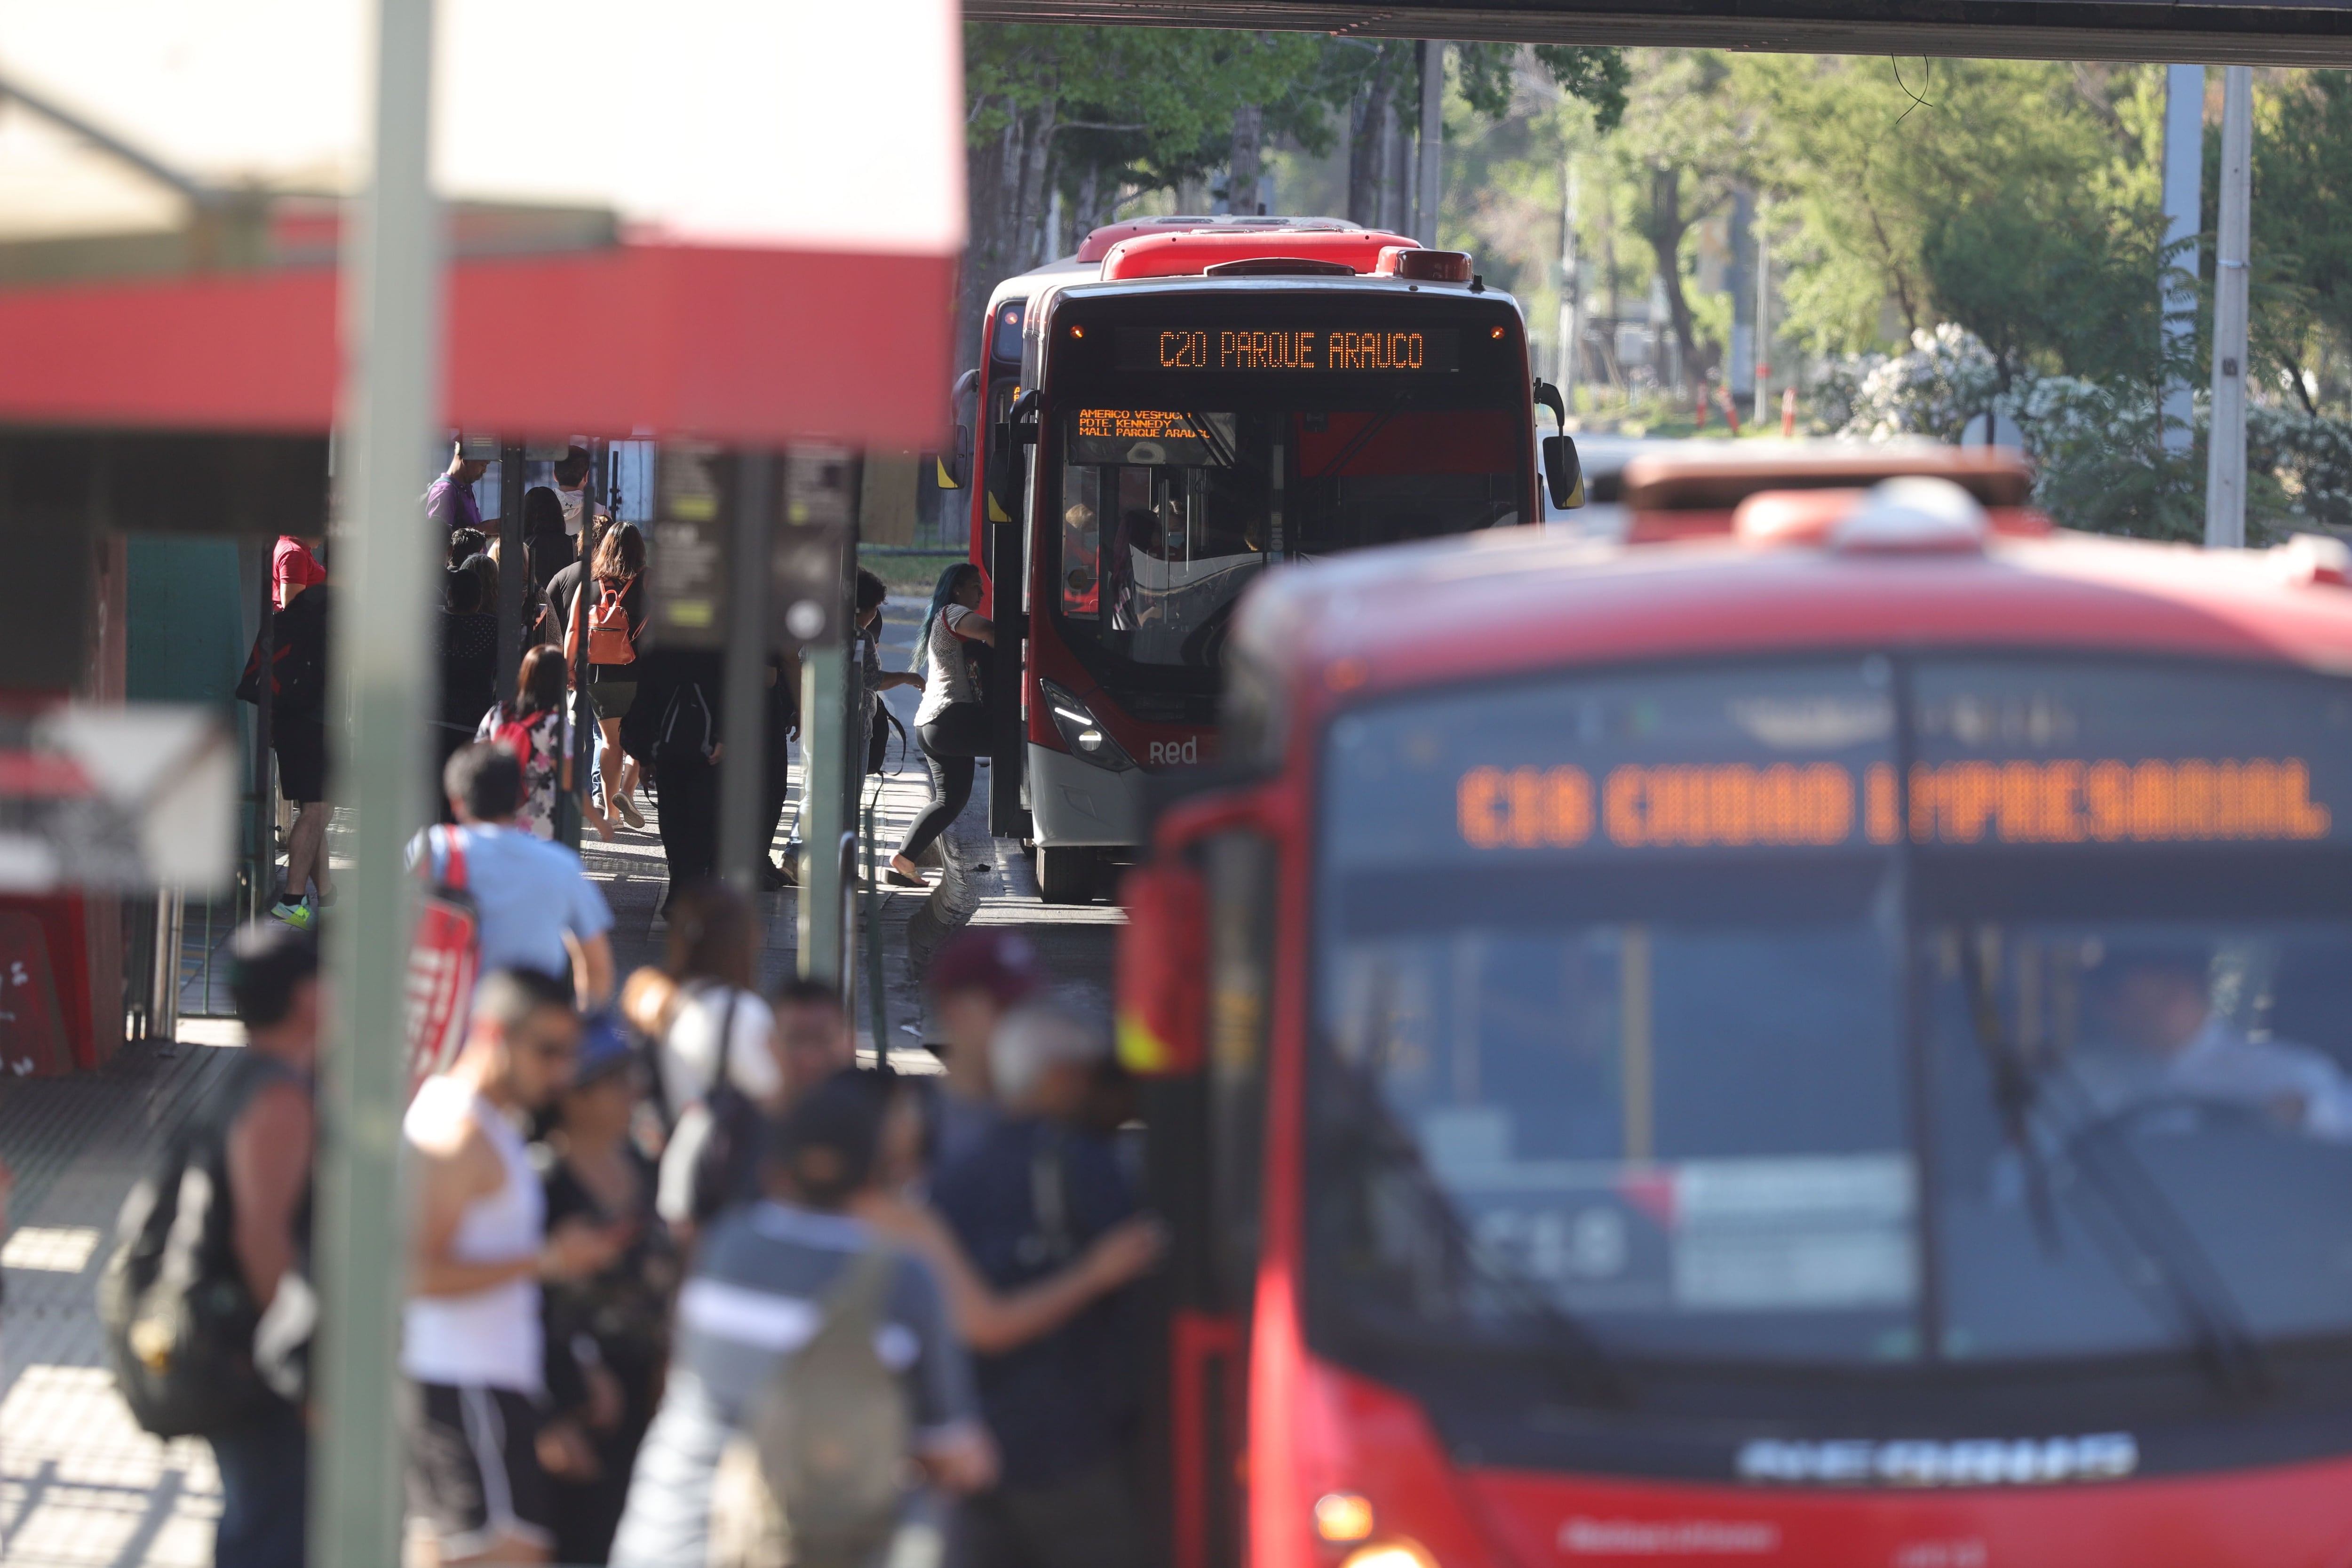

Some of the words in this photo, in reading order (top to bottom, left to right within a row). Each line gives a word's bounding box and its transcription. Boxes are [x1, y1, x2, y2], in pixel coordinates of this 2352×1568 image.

[1160, 332, 1206, 367] C20
[1222, 332, 1315, 368] PARQUE
[1329, 333, 1422, 368] ARAUCO
[1080, 409, 1129, 419] AMERICO
[1134, 410, 1191, 420] VESPUCI
[1079, 419, 1112, 428] PDTE.
[1116, 420, 1172, 428] KENNEDY
[1079, 427, 1111, 436] MALL
[1116, 428, 1160, 438] PARQUE
